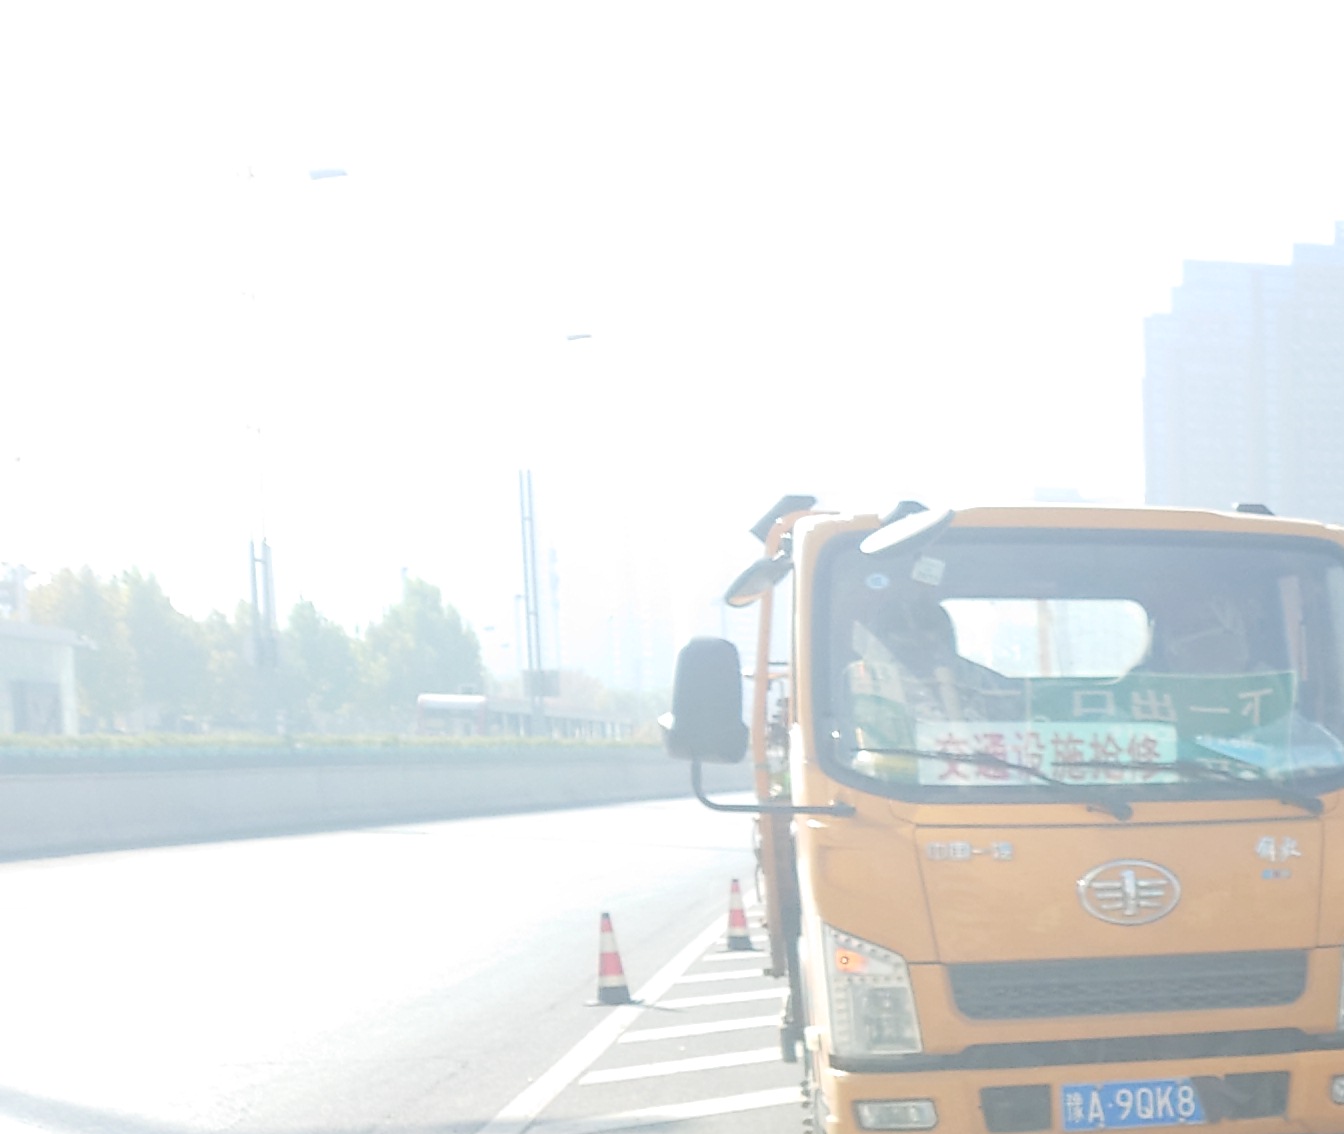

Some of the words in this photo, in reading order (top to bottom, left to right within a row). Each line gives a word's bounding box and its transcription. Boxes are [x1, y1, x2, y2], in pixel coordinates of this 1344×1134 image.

[934, 732, 1161, 781] 交通设施抢修
